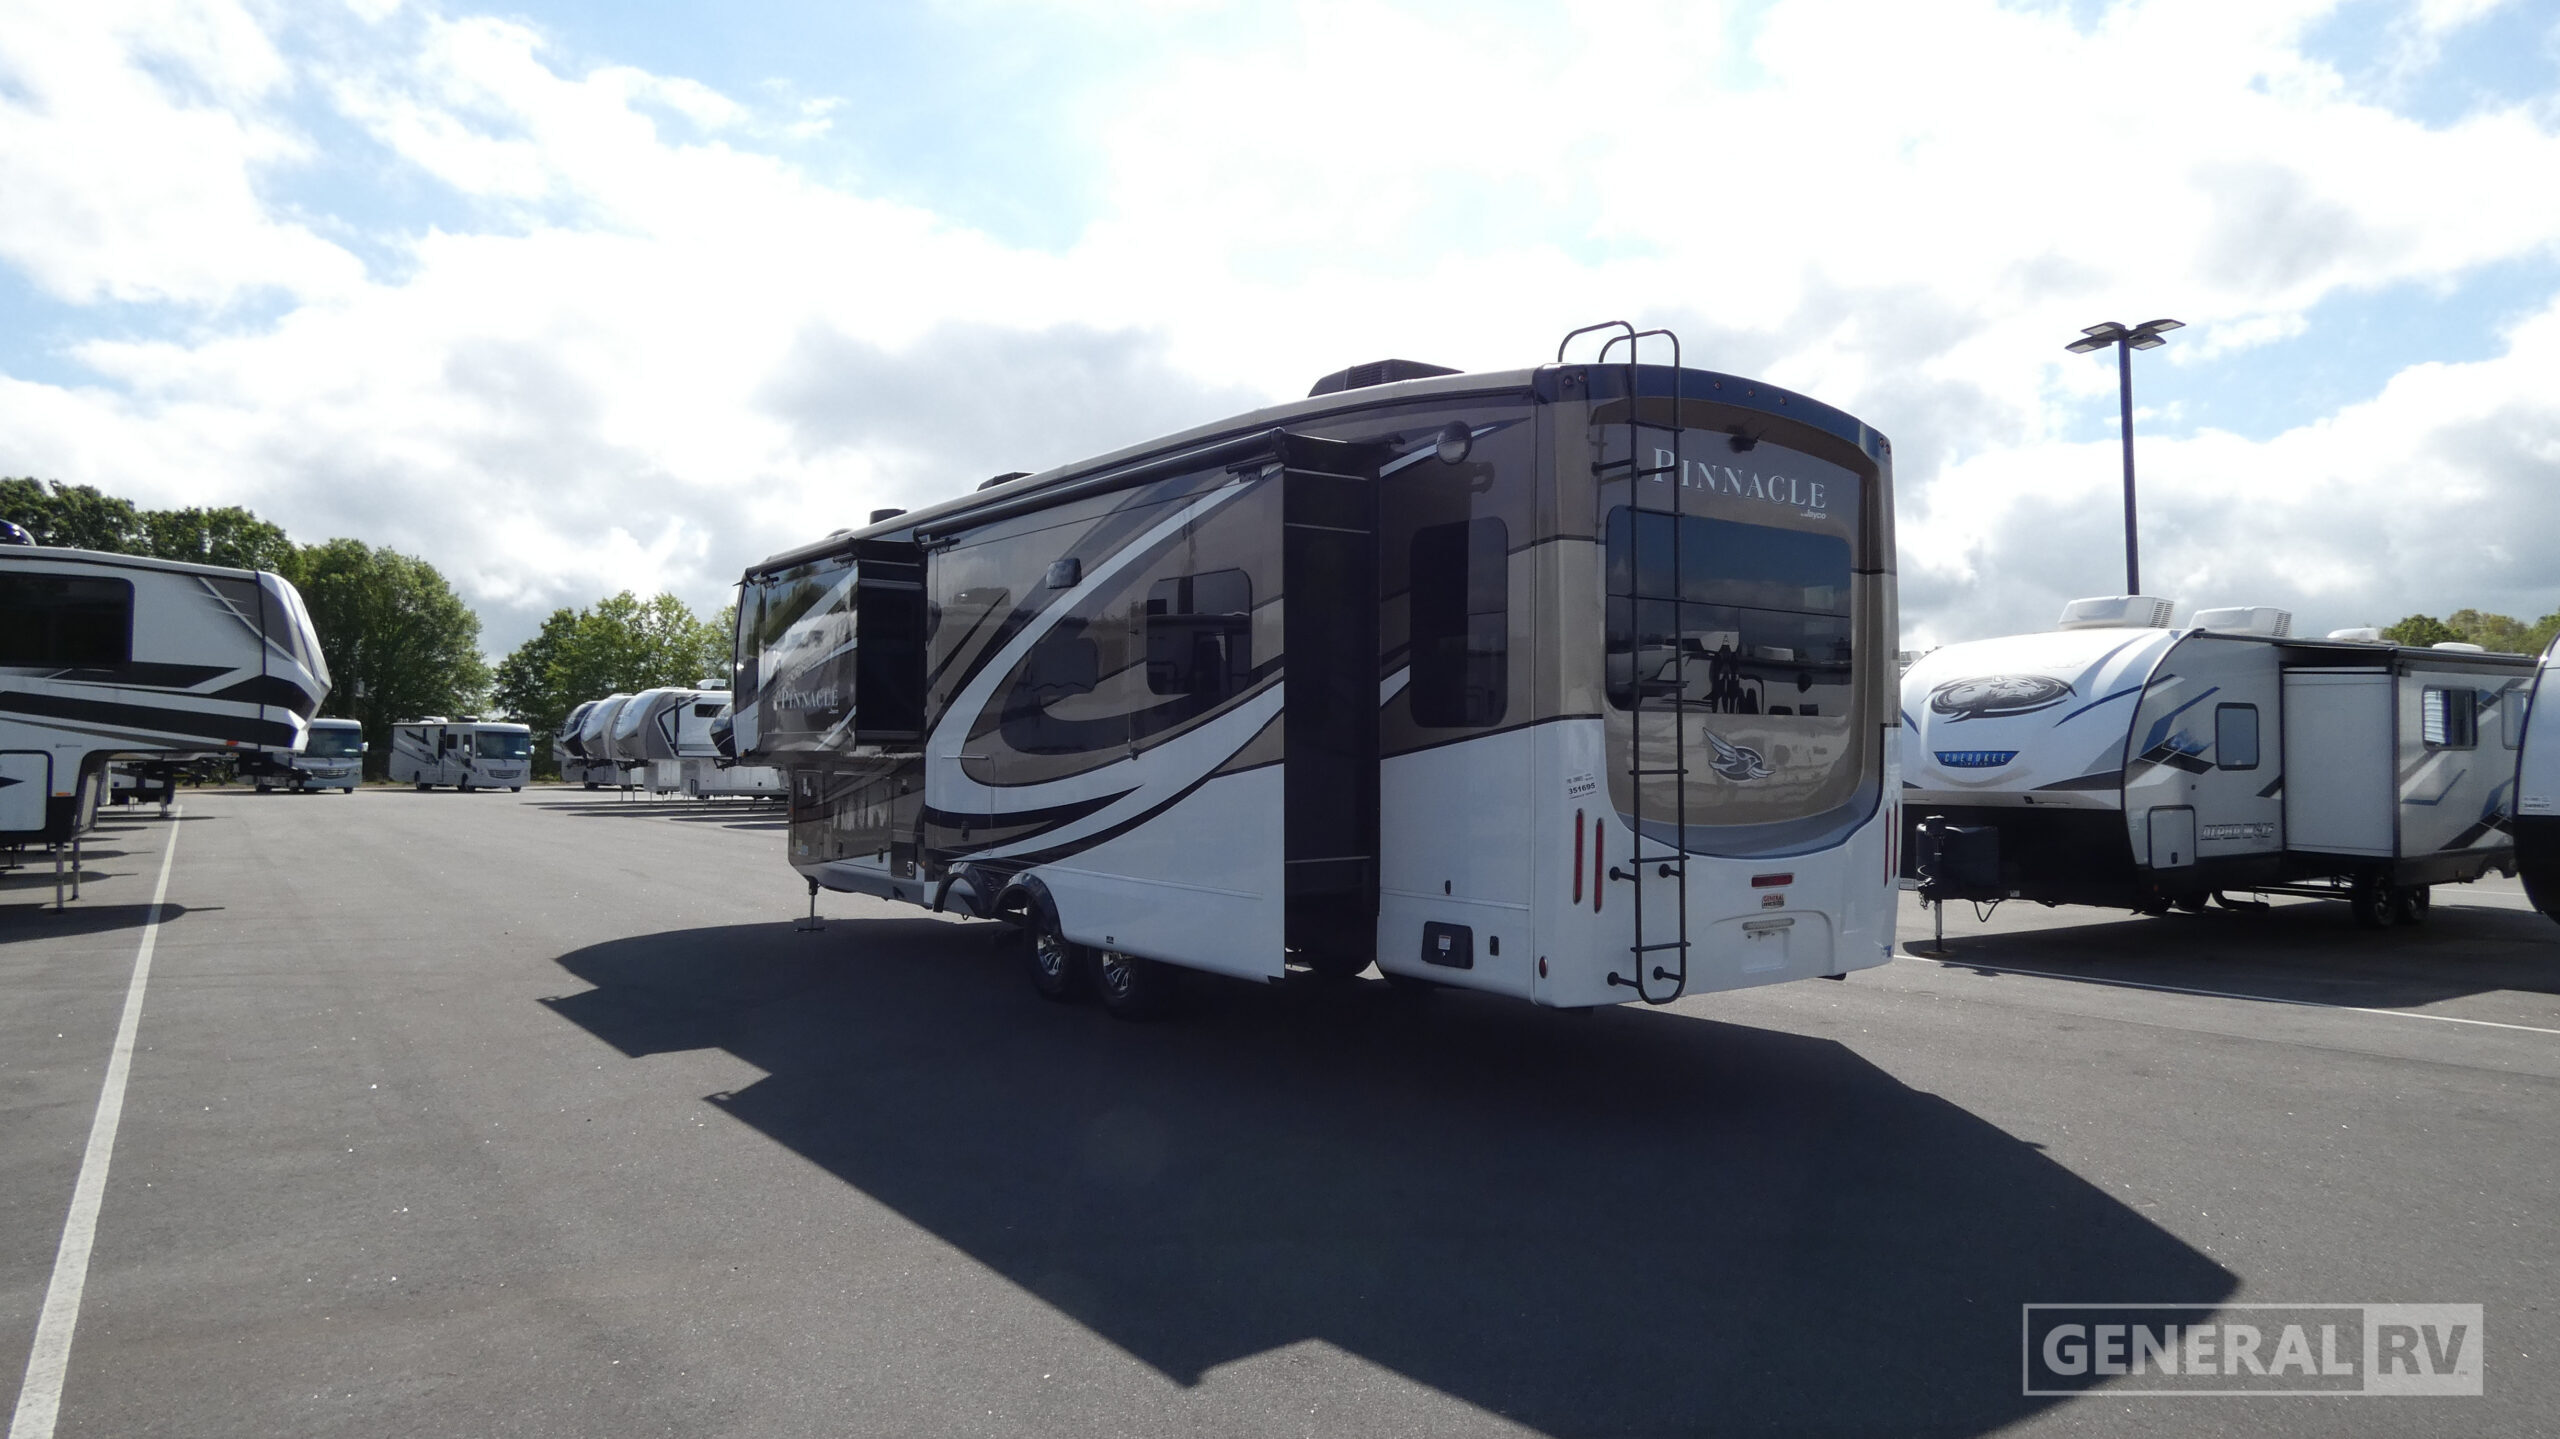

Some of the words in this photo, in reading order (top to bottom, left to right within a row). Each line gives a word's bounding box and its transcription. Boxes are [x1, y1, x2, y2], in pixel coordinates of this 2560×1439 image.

[1653, 447, 1827, 510] PINNACLE
[781, 689, 839, 709] PINNACLE
[1944, 753, 2006, 762] CHEROKEE
[1568, 782, 1596, 795] 351695
